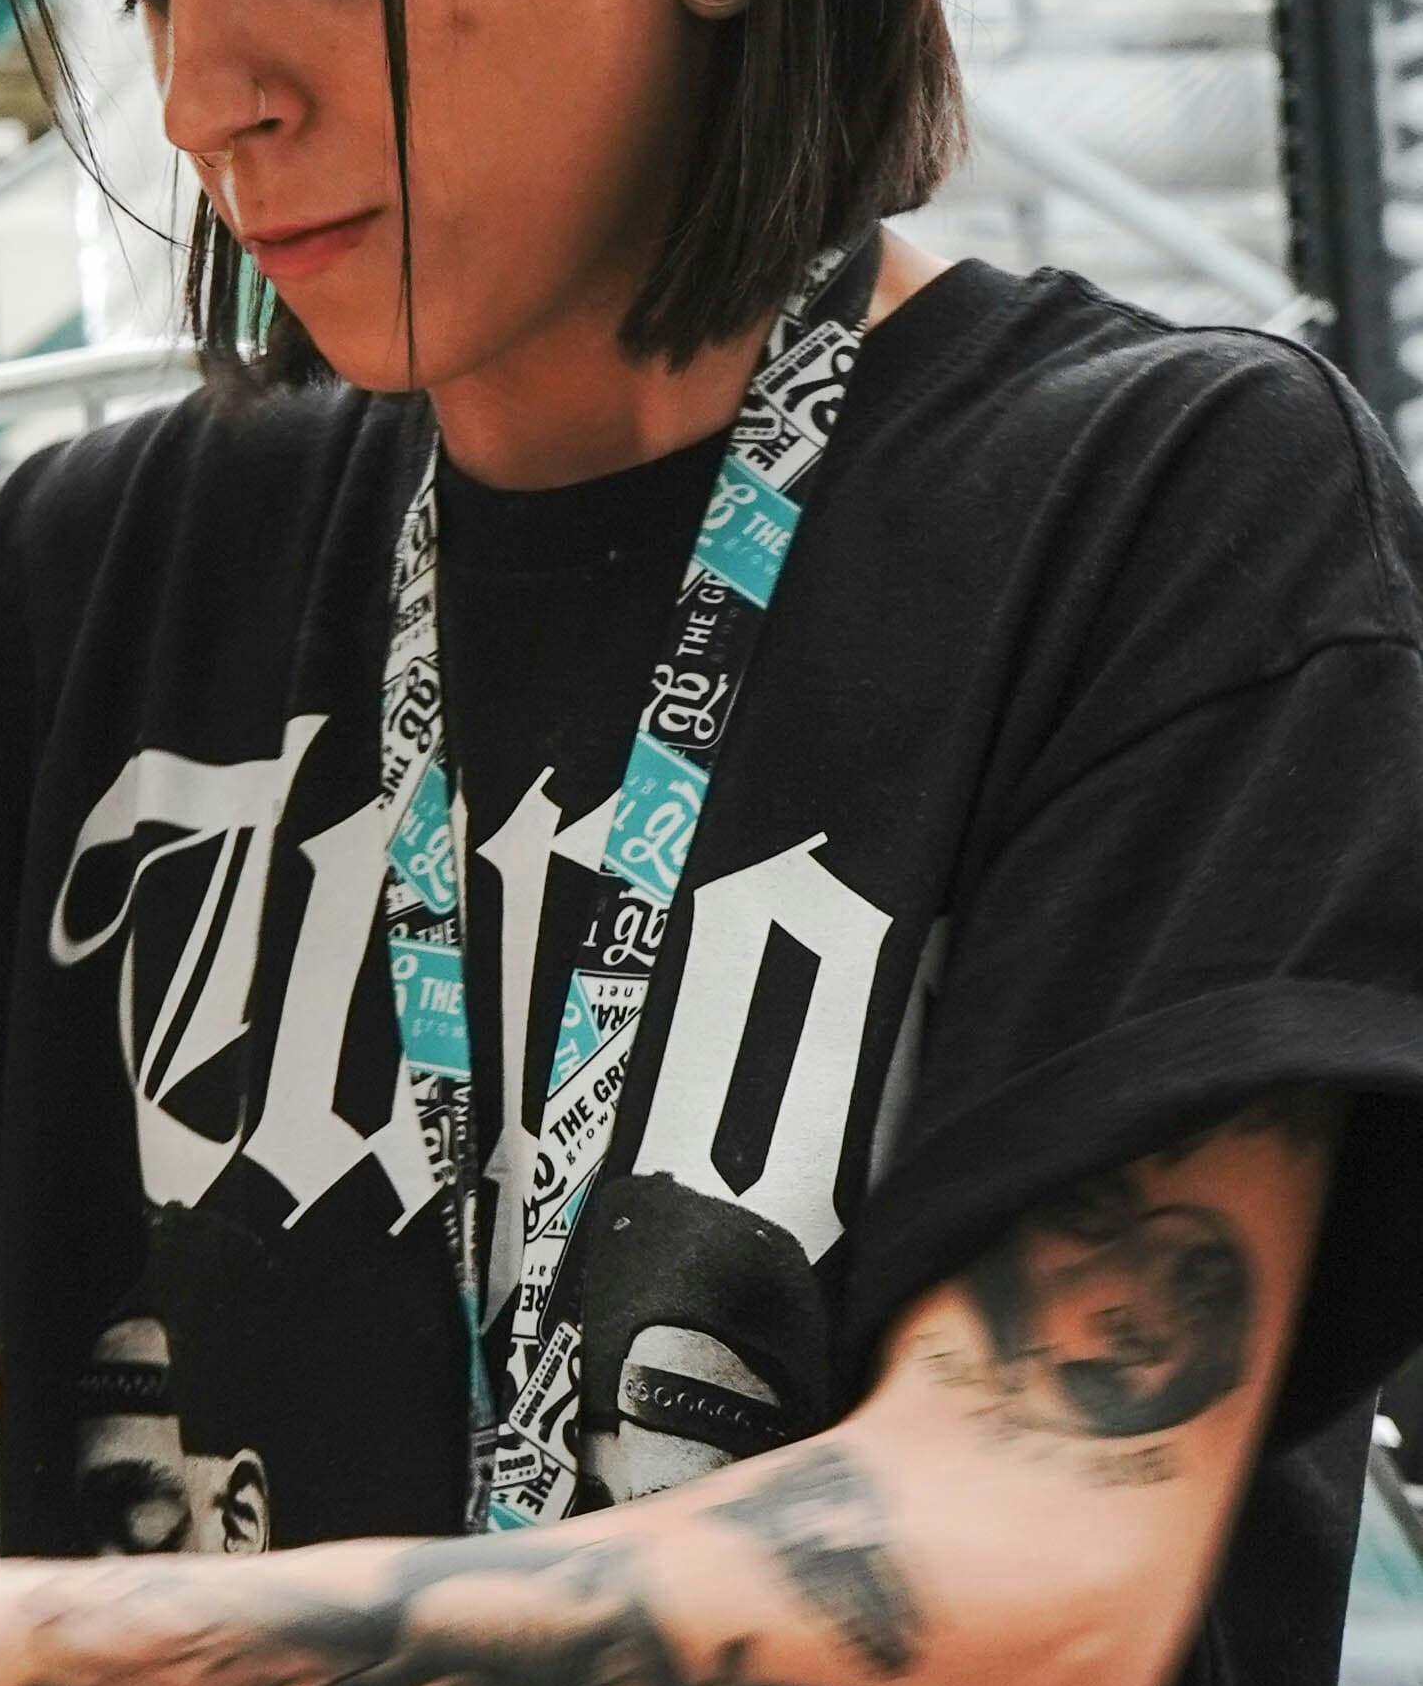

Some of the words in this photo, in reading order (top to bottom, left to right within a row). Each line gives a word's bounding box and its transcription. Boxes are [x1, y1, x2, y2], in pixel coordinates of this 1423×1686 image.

[742, 512, 791, 556] THE
[675, 611, 718, 658] THE
[419, 976, 463, 1014] THE
[548, 1096, 594, 1147] THE
